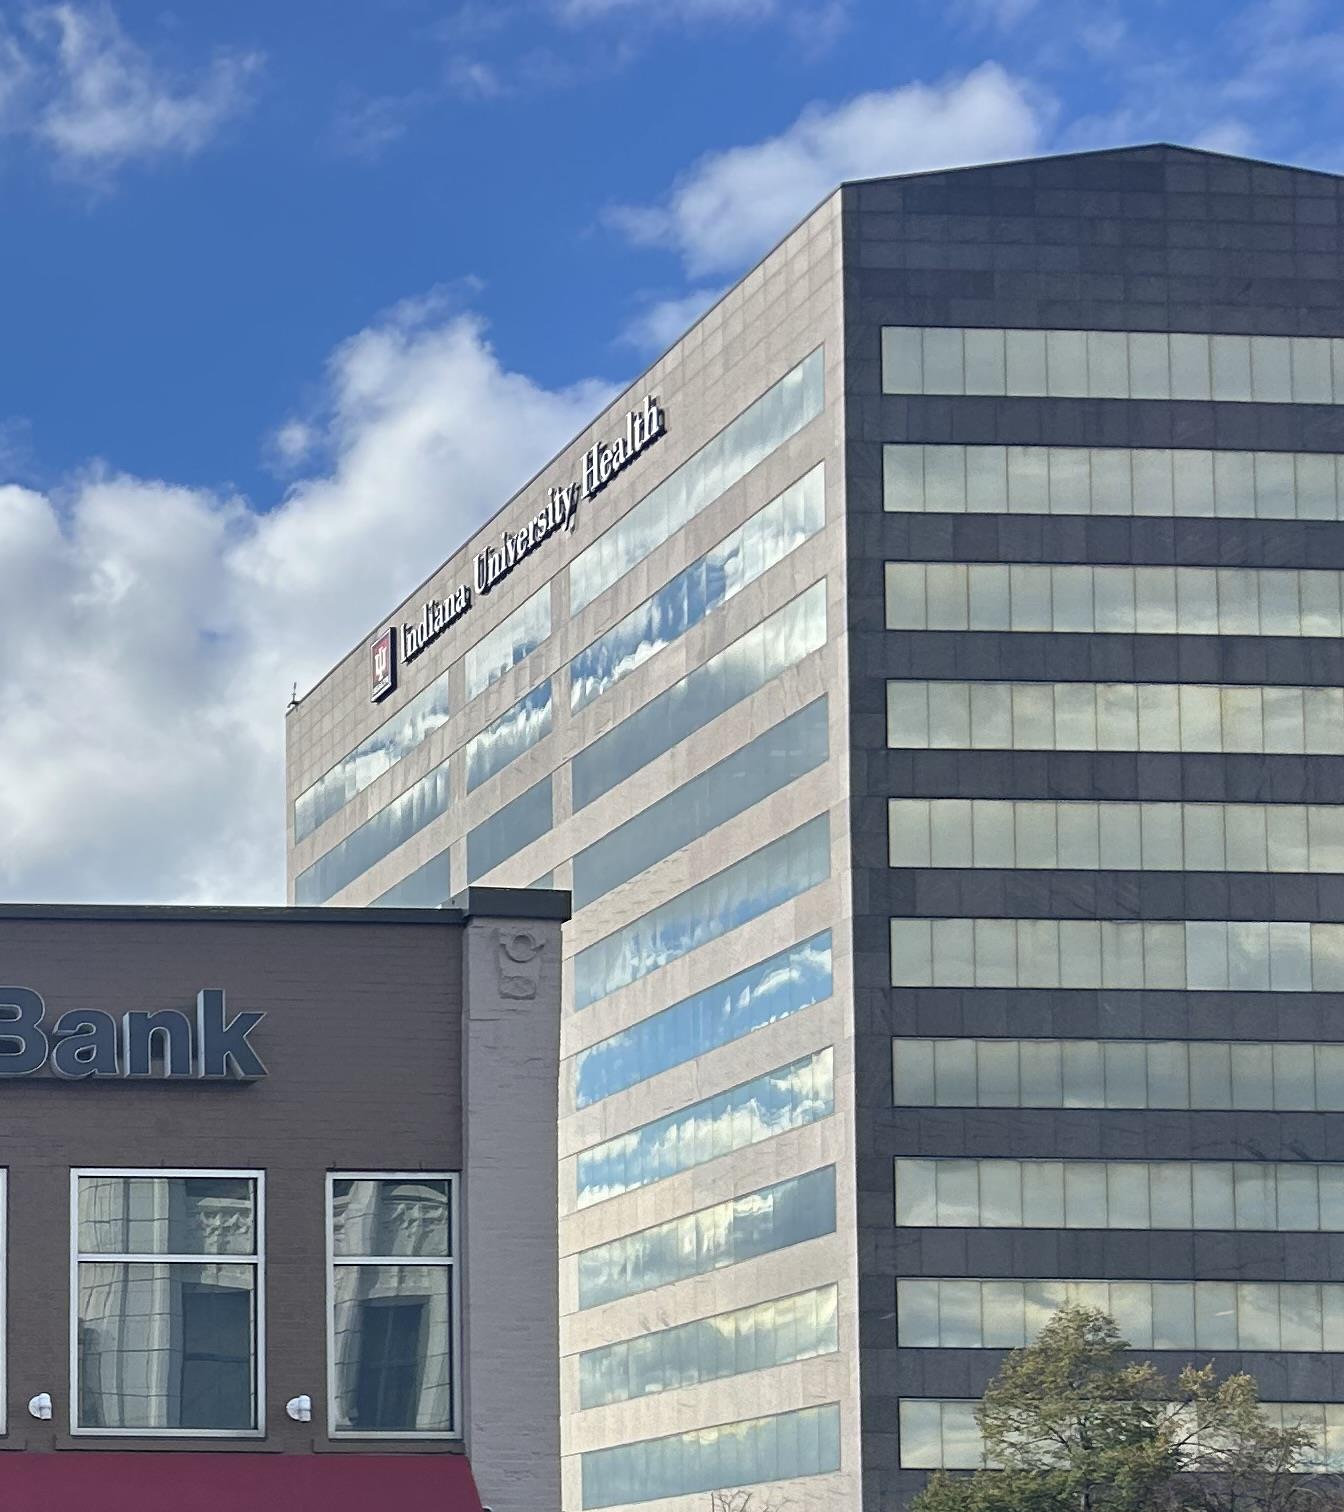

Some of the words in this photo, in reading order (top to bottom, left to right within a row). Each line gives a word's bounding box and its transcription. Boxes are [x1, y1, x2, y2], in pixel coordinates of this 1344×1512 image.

[400, 583, 469, 664] Indiana
[472, 481, 578, 595] University
[579, 395, 663, 500] Health
